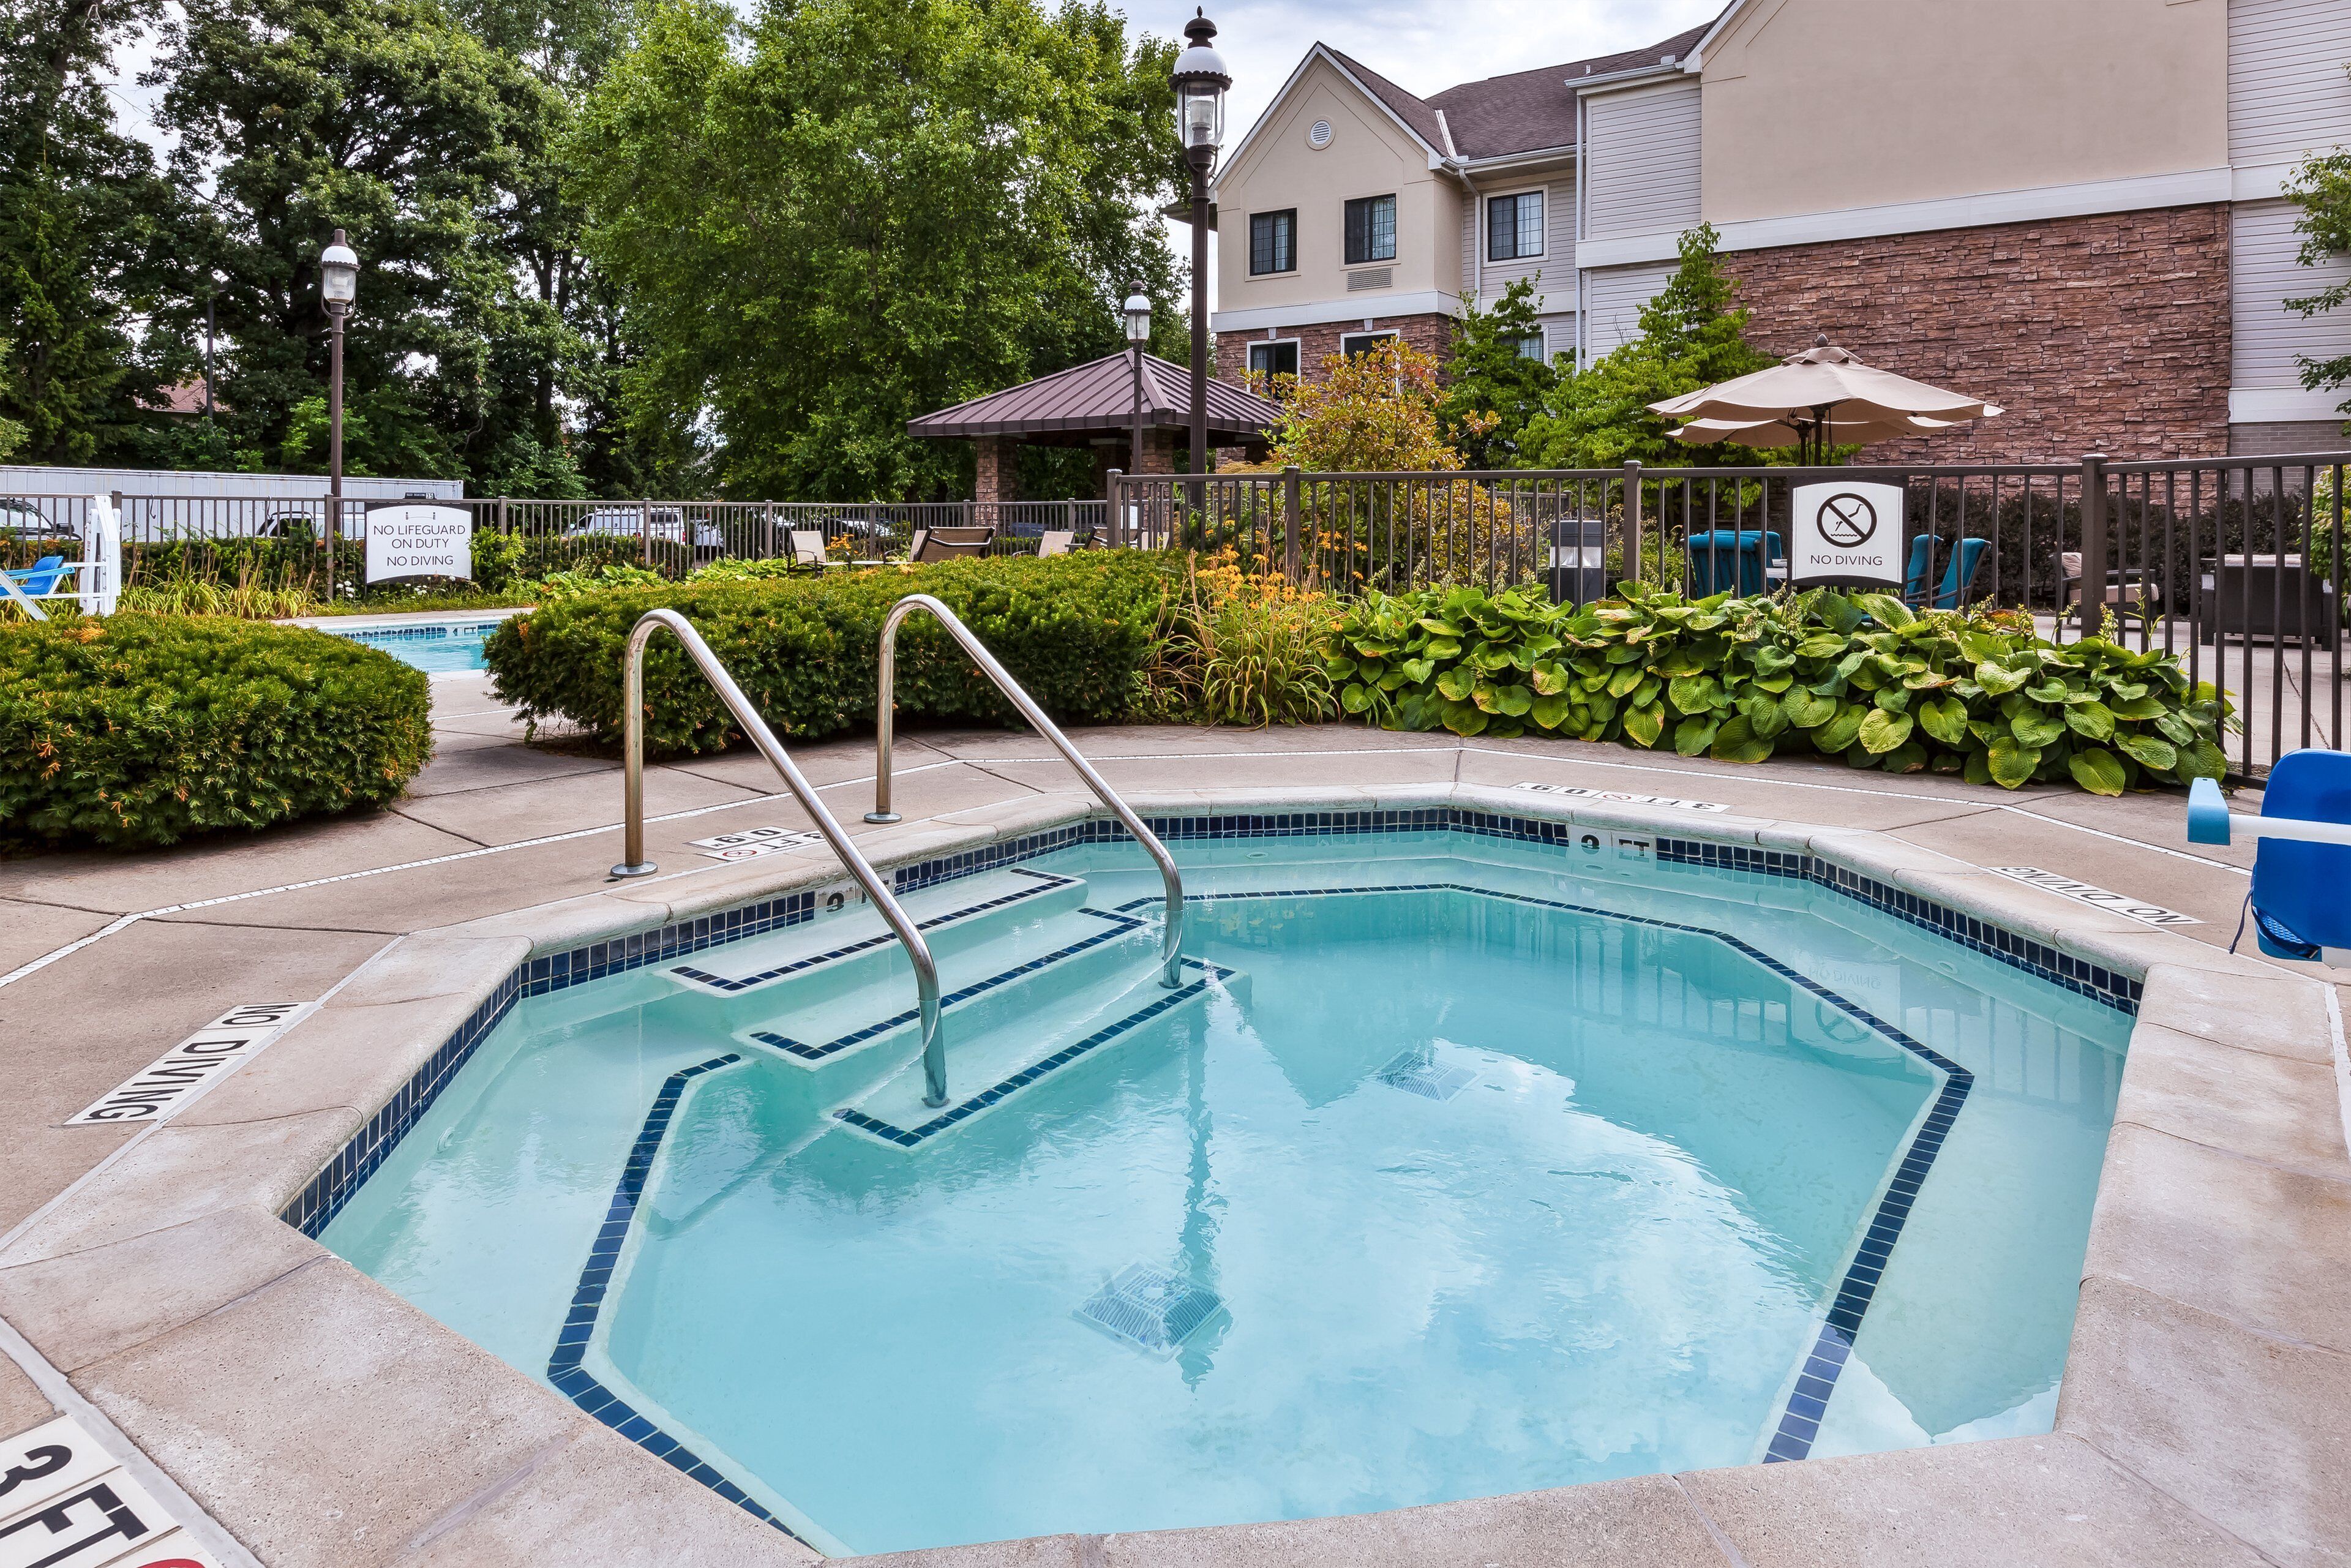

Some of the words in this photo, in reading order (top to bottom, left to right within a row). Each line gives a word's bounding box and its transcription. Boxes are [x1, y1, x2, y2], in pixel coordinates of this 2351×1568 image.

[373, 525, 394, 535] NO
[398, 525, 466, 535] LIFEGUARD
[392, 539, 412, 549] ON
[416, 538, 449, 549] DUTY
[387, 556, 407, 566] NO
[411, 555, 454, 566] DIVING
[1810, 555, 1832, 565] NO
[1835, 555, 1883, 566] DIVING
[759, 839, 804, 850] FT
[2000, 867, 2126, 901] DIVING
[2127, 907, 2194, 923] NO
[221, 1003, 300, 1025] NO
[83, 1039, 252, 1121] DIVING
[0, 1482, 150, 1568] FT
